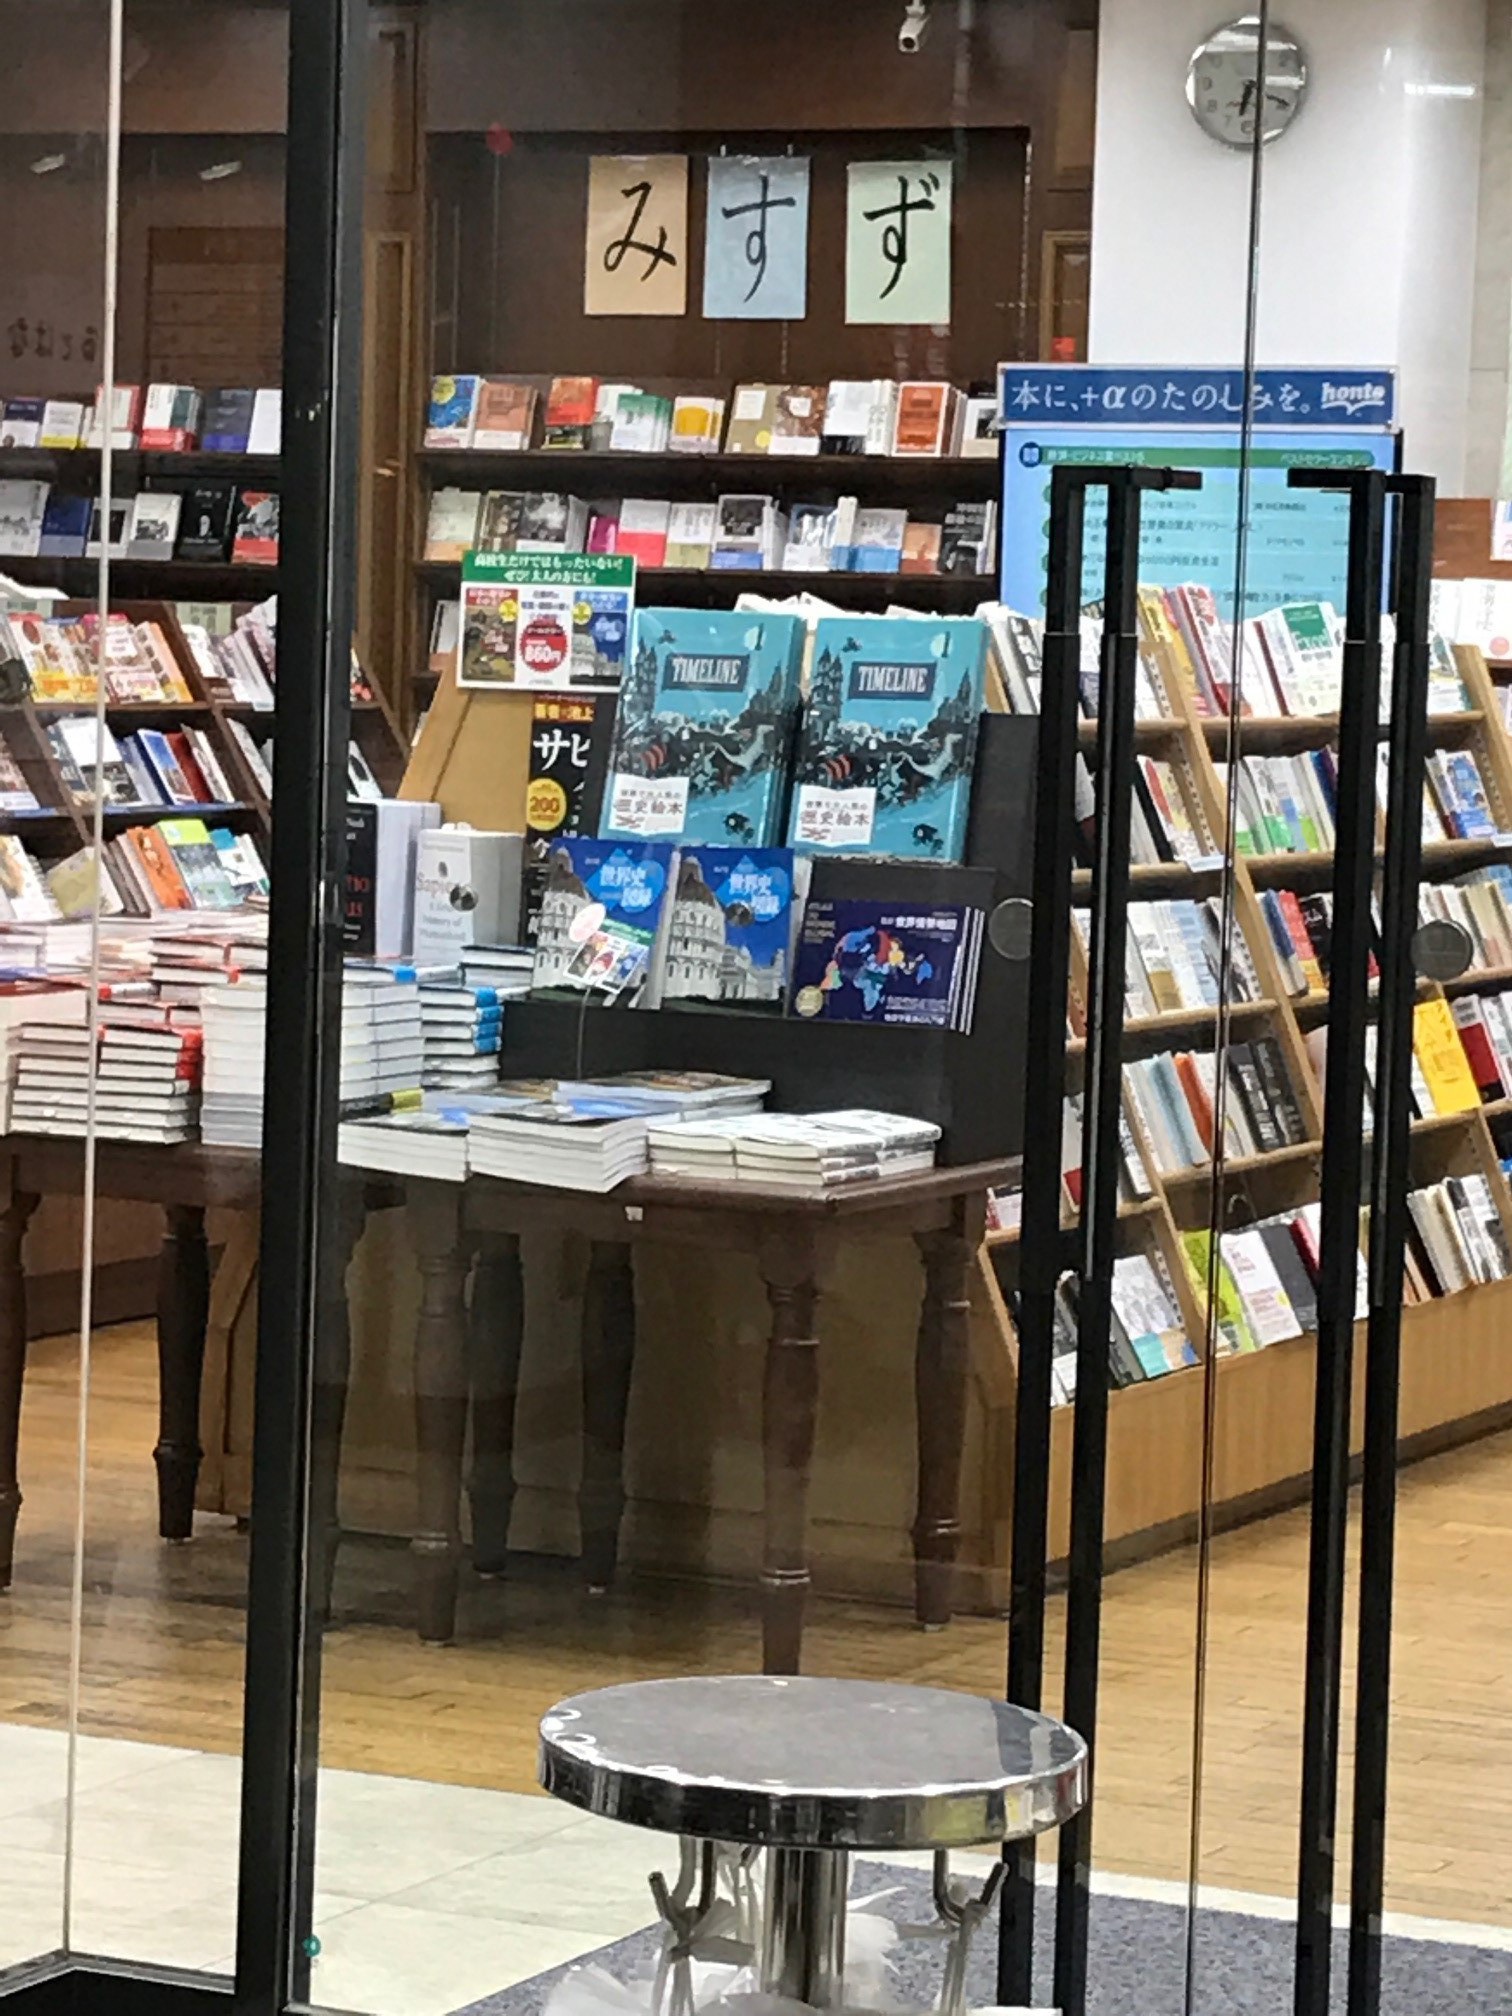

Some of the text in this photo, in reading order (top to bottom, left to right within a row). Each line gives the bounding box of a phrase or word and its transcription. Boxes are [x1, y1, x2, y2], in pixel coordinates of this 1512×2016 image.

[603, 171, 940, 302] み す ず
[672, 656, 742, 685] TIMELINE
[857, 665, 928, 693] TIMELINE
[600, 863, 647, 888] 世界史
[729, 873, 773, 896] 世界史
